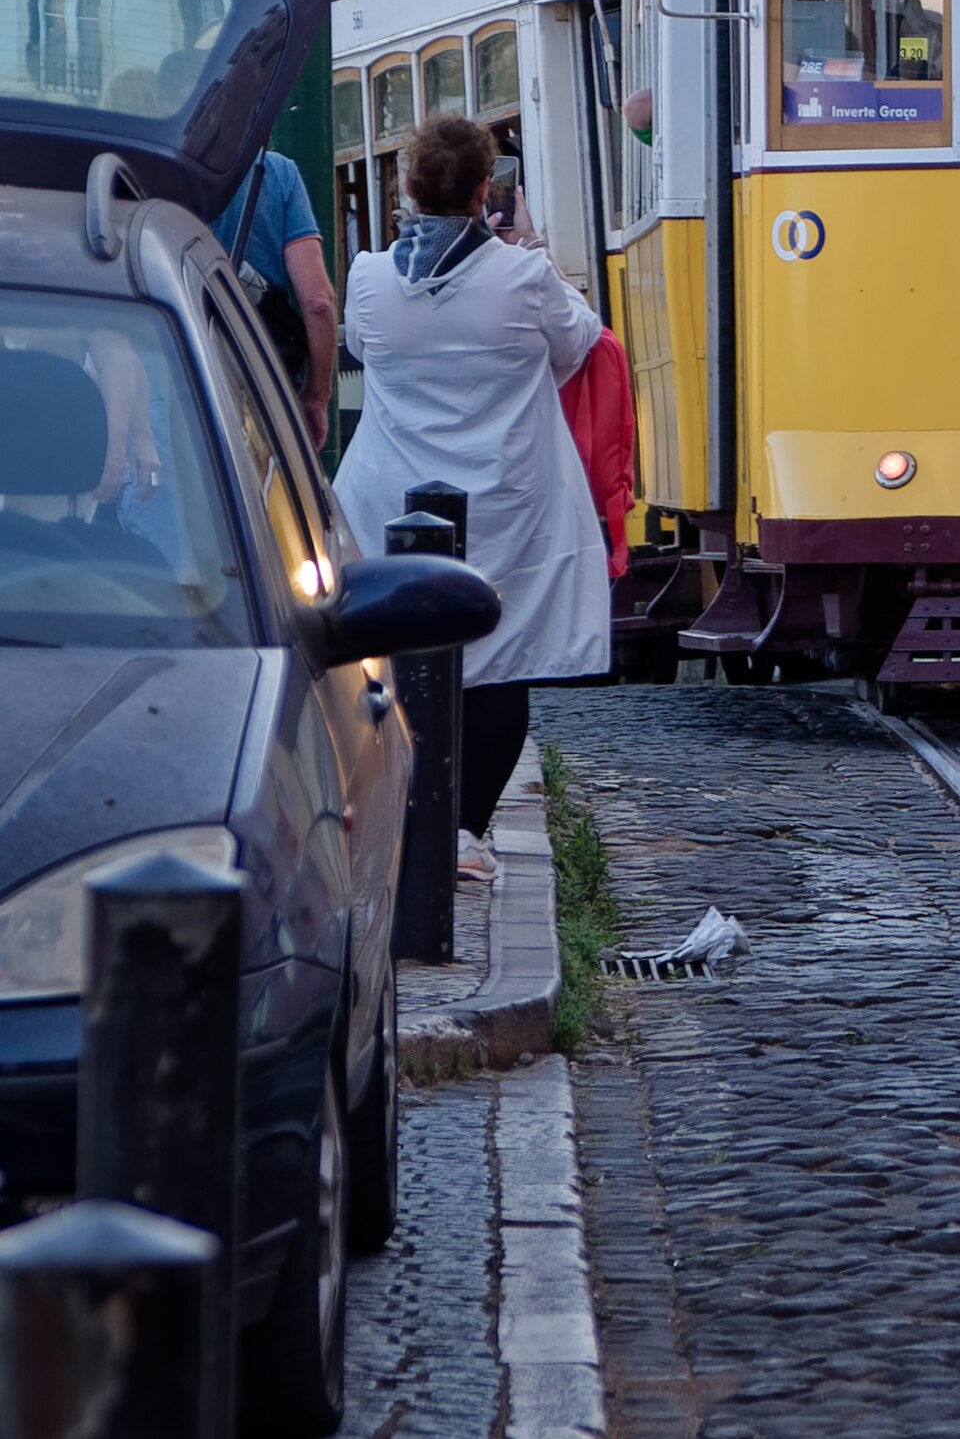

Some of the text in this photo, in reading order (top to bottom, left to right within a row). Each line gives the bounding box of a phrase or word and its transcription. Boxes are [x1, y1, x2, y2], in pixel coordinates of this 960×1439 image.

[800, 62, 823, 74] 28E
[832, 105, 917, 120] Inverte Graça
